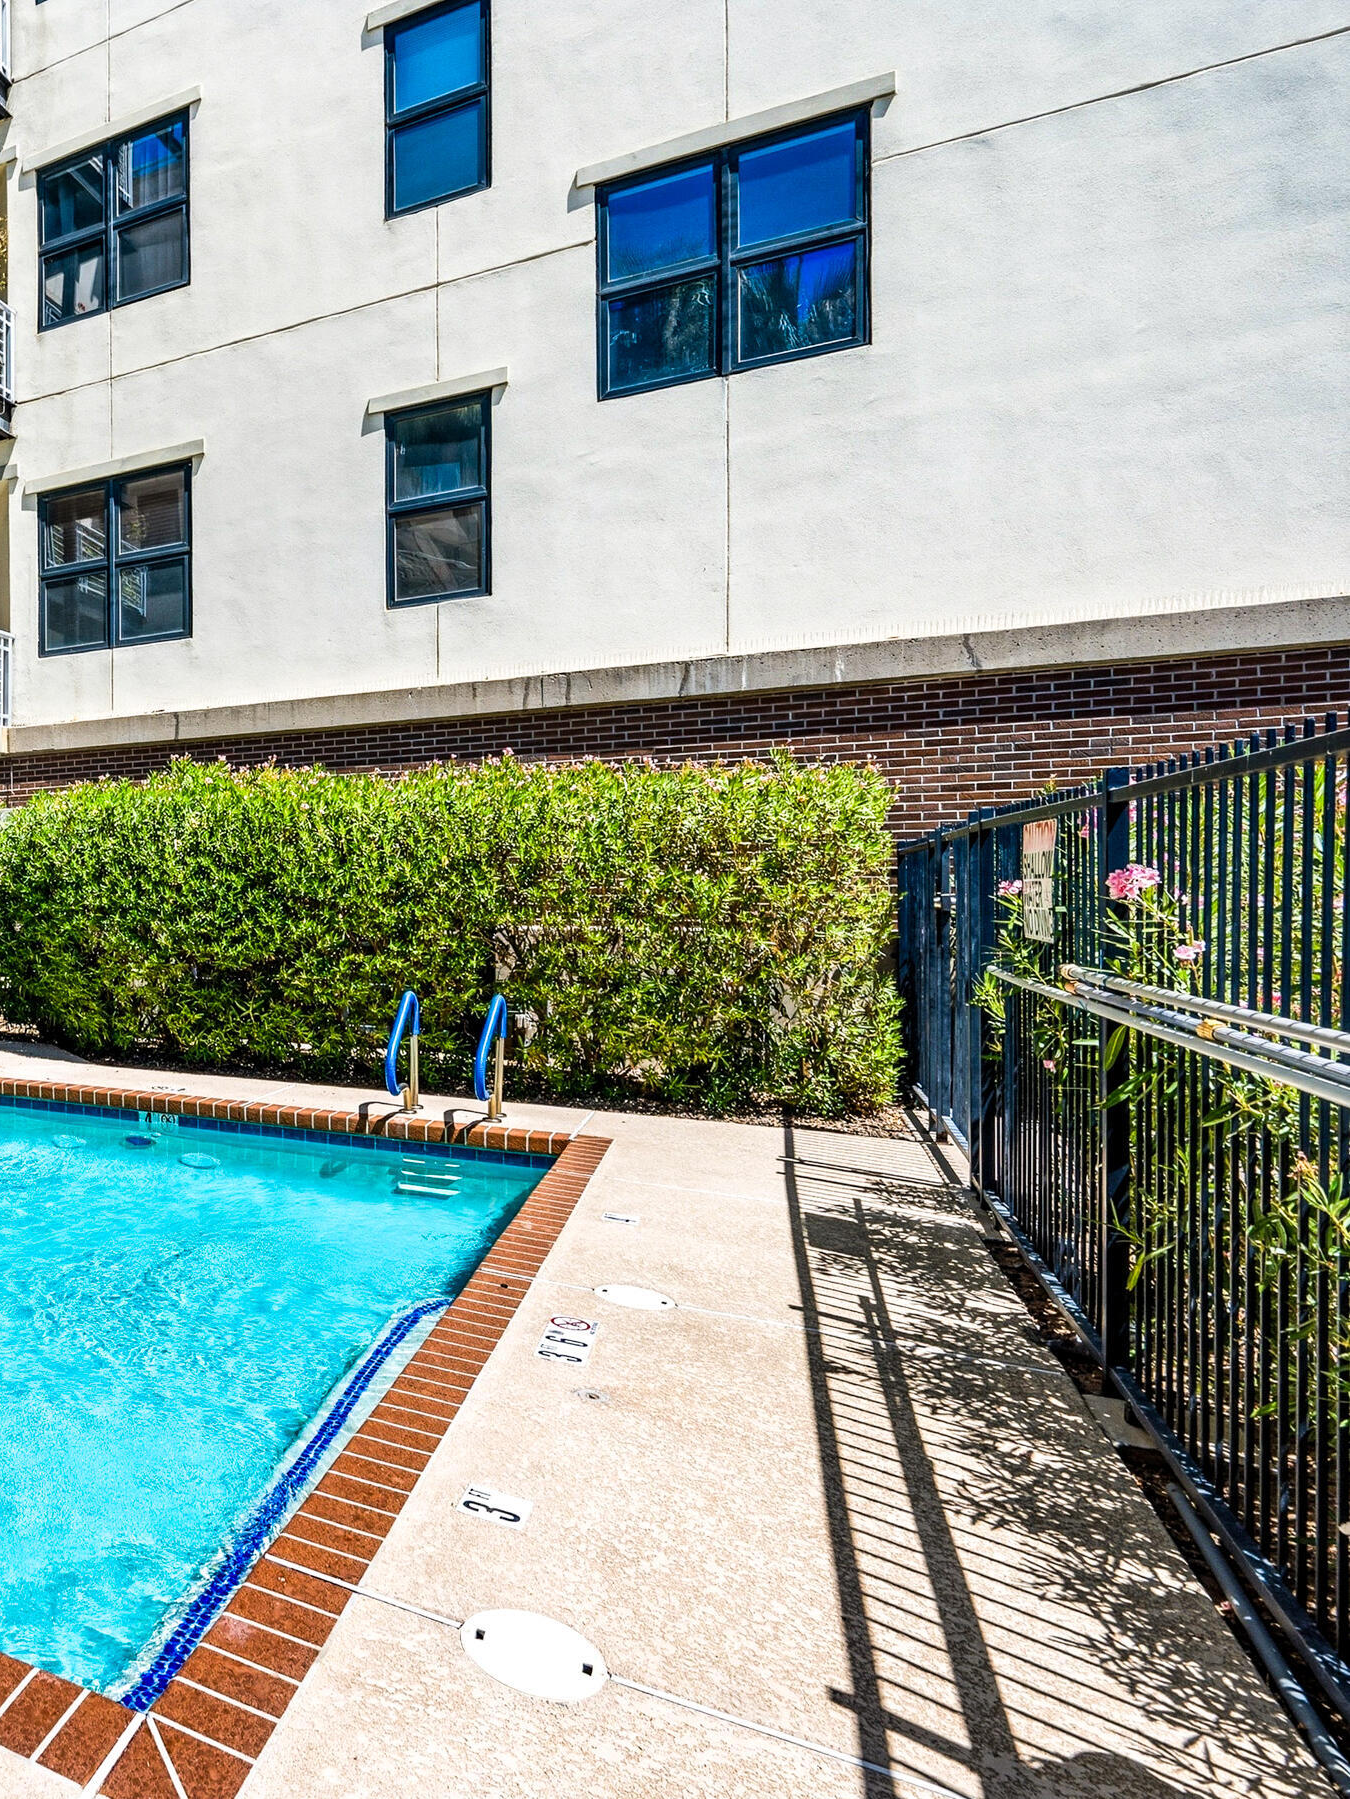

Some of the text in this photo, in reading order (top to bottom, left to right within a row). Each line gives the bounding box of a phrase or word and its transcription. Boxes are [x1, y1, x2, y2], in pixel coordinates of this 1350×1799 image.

[545, 1335, 588, 1348] 6
[538, 1350, 582, 1363] 3
[462, 1500, 521, 1522] 3
